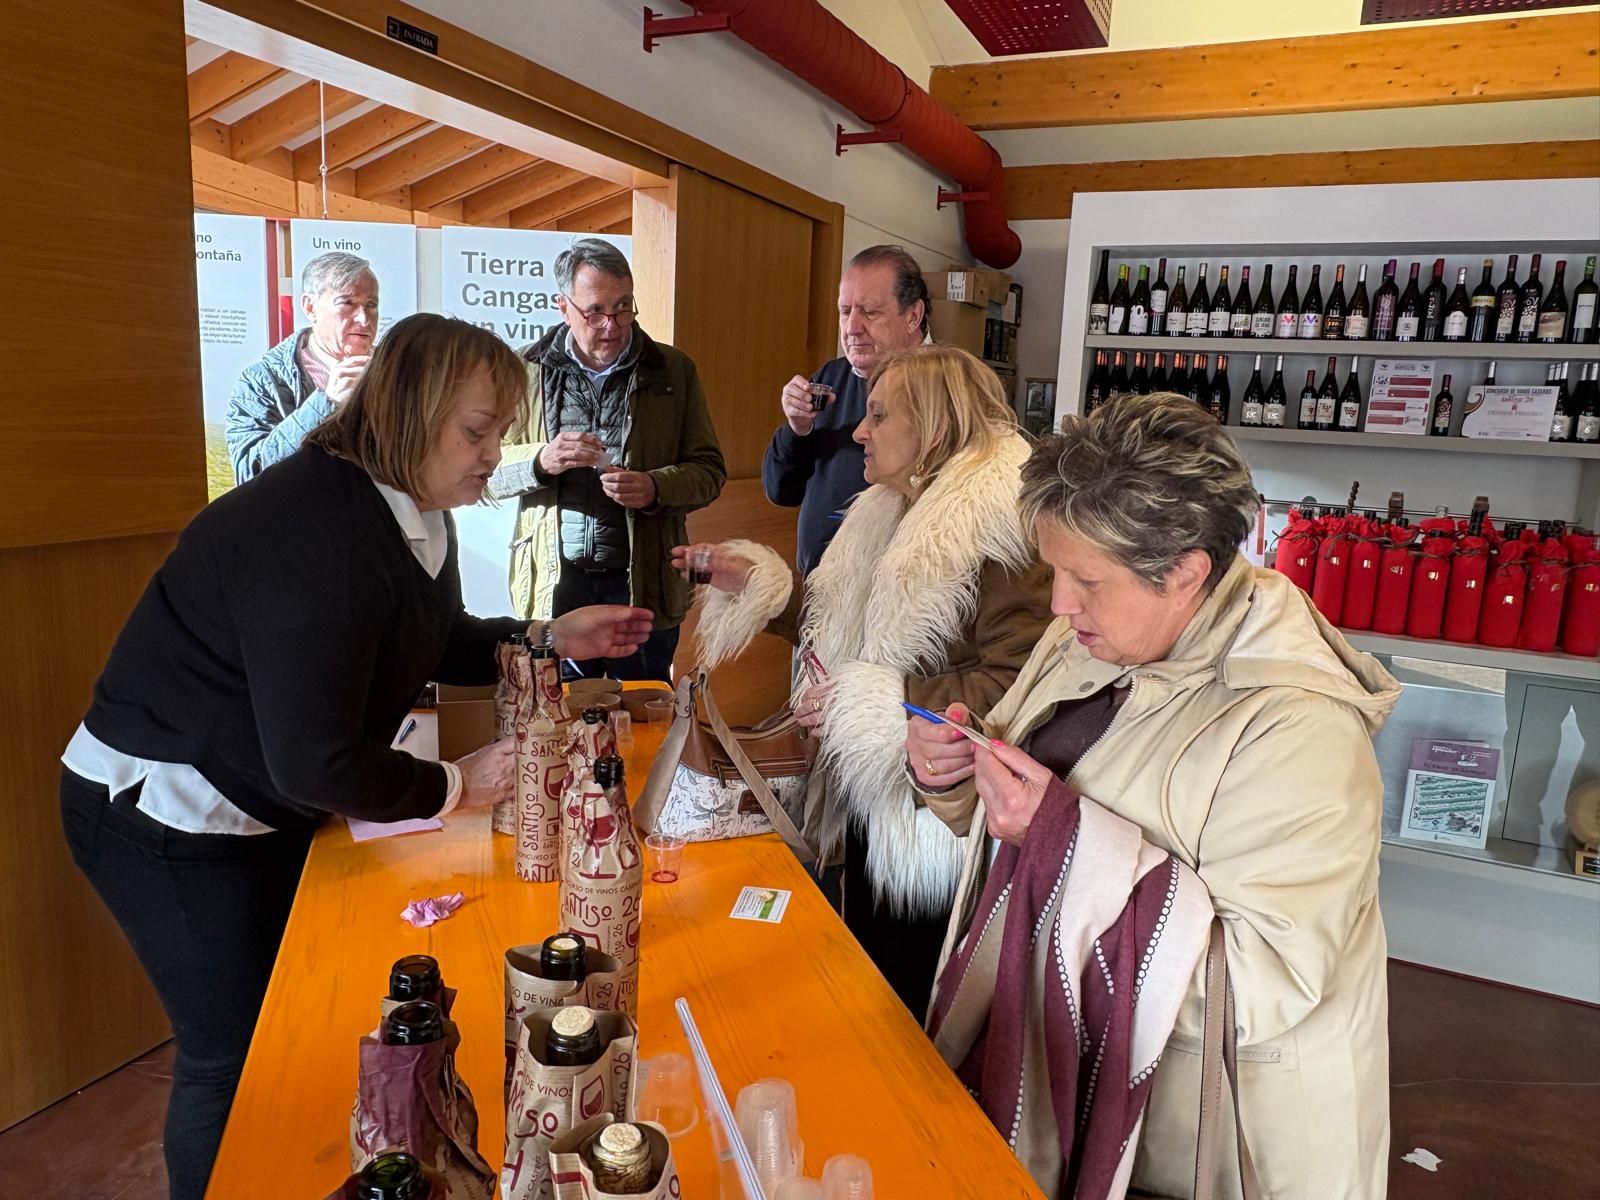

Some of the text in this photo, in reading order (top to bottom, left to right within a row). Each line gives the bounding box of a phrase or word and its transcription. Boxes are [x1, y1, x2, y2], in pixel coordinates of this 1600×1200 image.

[312, 237, 362, 251] Un vino
[461, 250, 545, 278] Tierra
[462, 282, 561, 315] Cangas
[521, 762, 539, 785] 26
[523, 991, 537, 1003] DE
[596, 981, 613, 998] 26
[612, 1052, 631, 1075] 26
